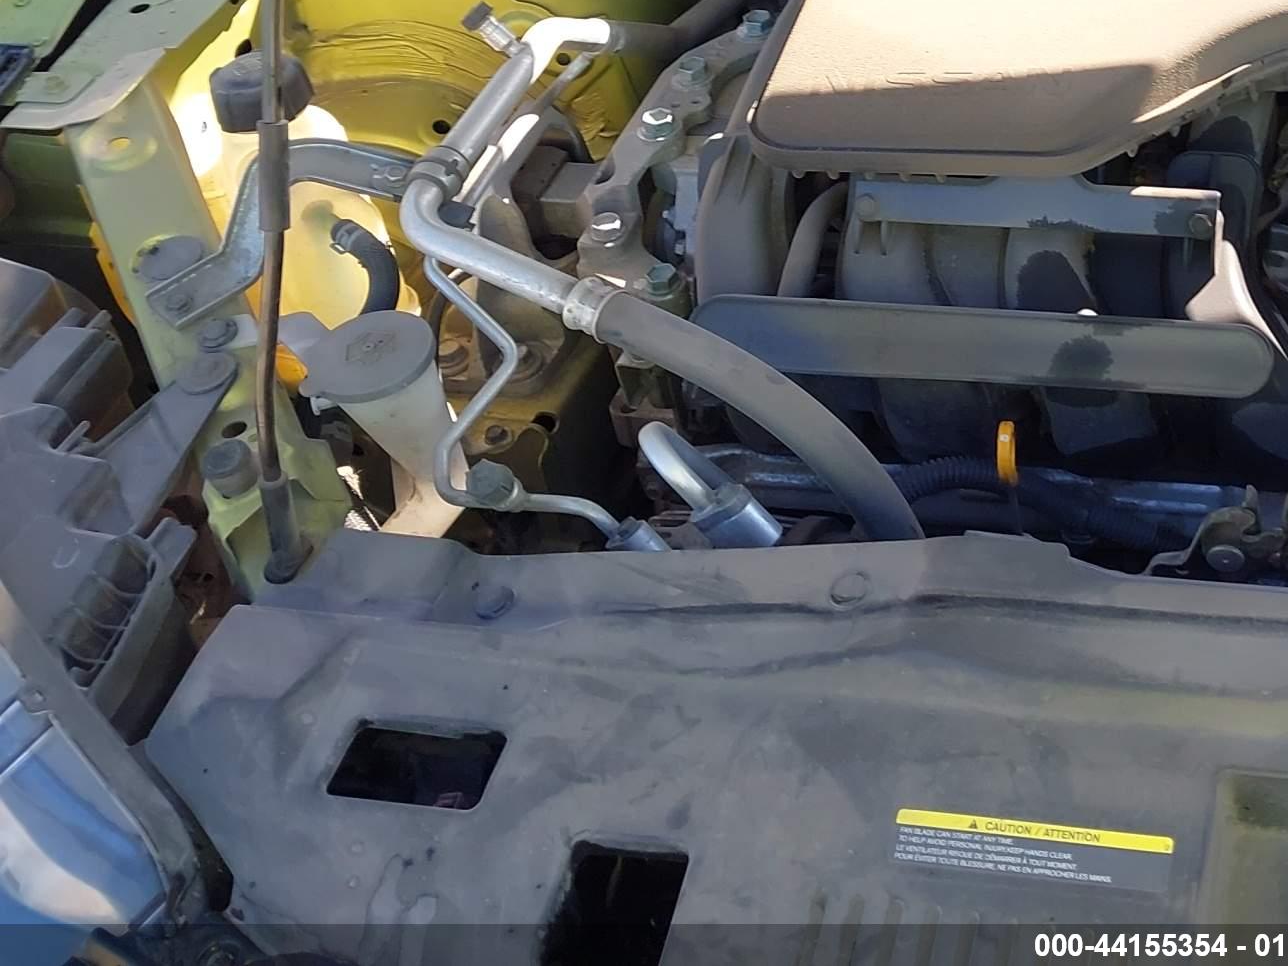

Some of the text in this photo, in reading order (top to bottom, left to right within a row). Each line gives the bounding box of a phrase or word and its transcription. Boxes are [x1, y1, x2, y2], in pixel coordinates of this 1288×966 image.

[985, 821, 1101, 843] CAUTION / ATTENTION
